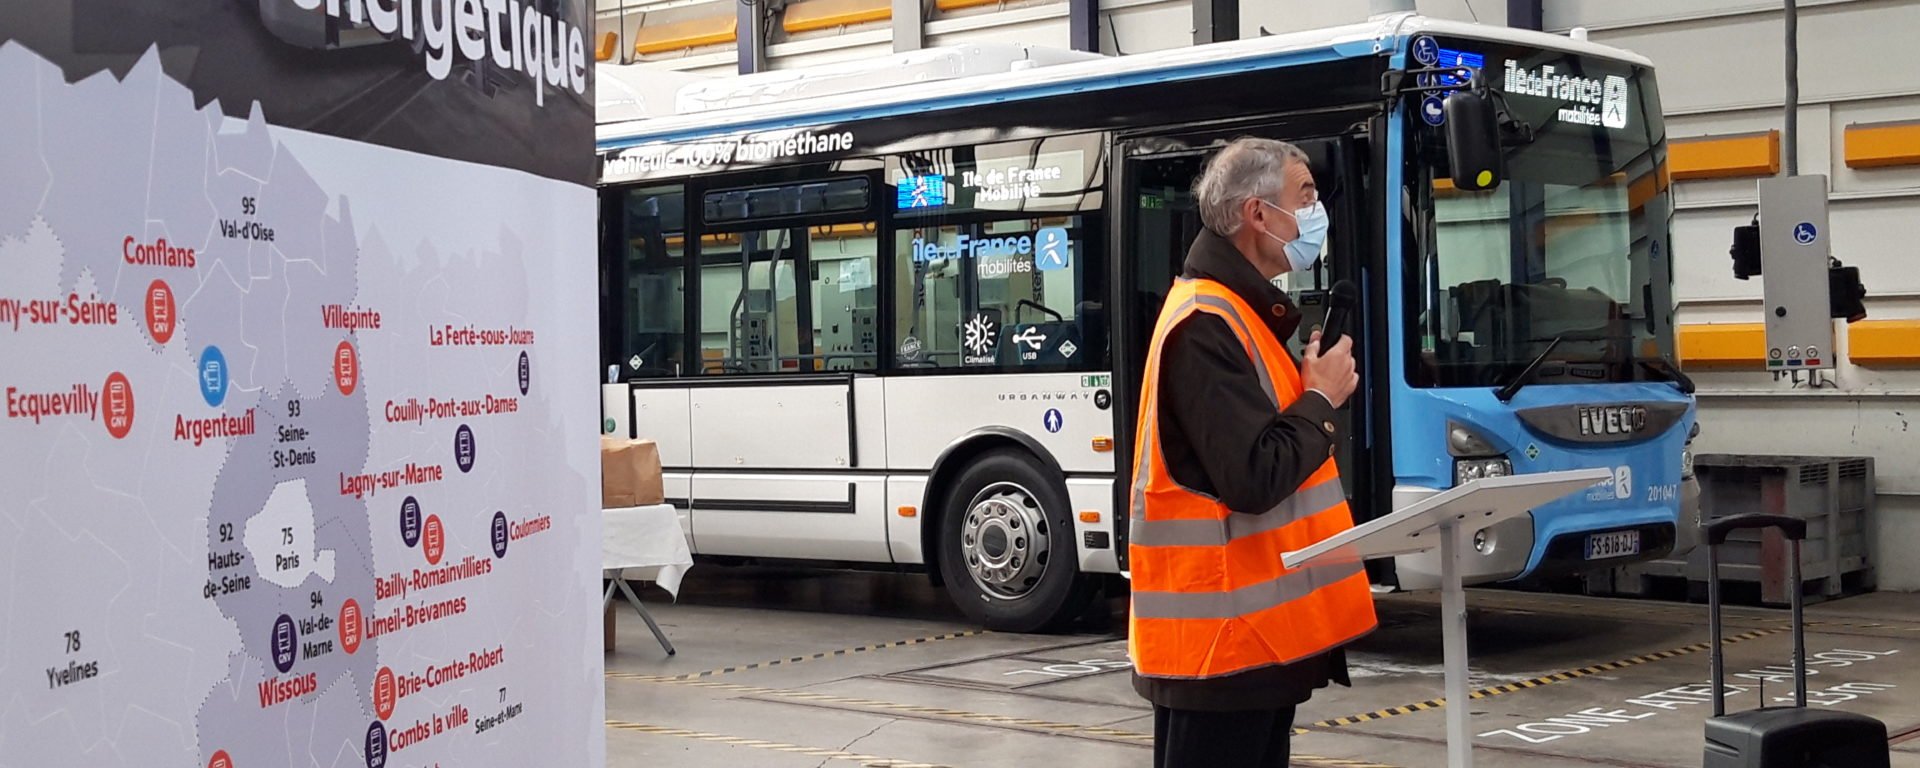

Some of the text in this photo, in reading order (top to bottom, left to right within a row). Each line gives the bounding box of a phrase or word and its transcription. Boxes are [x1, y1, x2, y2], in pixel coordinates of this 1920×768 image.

[683, 142, 731, 168] 100%
[735, 129, 853, 163] biométhane
[962, 165, 1062, 188] Ile de France
[980, 181, 1041, 203] Mobilité
[242, 197, 256, 215] 95
[220, 219, 275, 242] Val-d'Oise
[123, 235, 196, 268] Conflans
[977, 254, 1032, 276] mobilités
[322, 304, 381, 333] Villepinte
[430, 325, 443, 345] La
[964, 354, 995, 364] Climatisé
[1022, 352, 1037, 360] USB
[6, 384, 98, 425] Ecquevilly
[998, 392, 1089, 401] URBANWAY
[288, 400, 301, 418] 93
[385, 394, 518, 425] Couilly-Pont-aux-Dames
[1579, 404, 1647, 435] IVECO
[110, 416, 127, 428] GNV
[174, 407, 256, 446] Argenteuil
[278, 425, 309, 443] Seine-
[273, 446, 316, 468] St-Denis
[339, 462, 442, 499] Lagny-sur-Marne
[1647, 484, 1677, 502] 201047
[219, 523, 234, 542] 92
[281, 527, 294, 546] 75
[510, 512, 551, 541] Coulommiers
[1591, 533, 1633, 555] FS-618-DJ
[208, 550, 245, 571] Hauts-
[275, 551, 300, 571] Paris
[203, 575, 251, 599] de-Seine
[375, 556, 492, 600] Bailly-Romainvilliers
[310, 591, 323, 609] 94
[299, 613, 334, 636] Val-de-
[365, 597, 467, 639] Limeil-Brévannes
[63, 630, 81, 654] 78
[303, 639, 333, 660] Marne
[46, 657, 99, 690] Yvelines
[398, 644, 504, 698] Brie-Comte-Robert
[258, 672, 317, 709] Wissous
[499, 687, 506, 703] 77
[1477, 707, 1657, 743] ZONE
[1625, 680, 1748, 710] ATEX
[1805, 648, 1899, 667] SOL
[389, 704, 469, 752] Combs la ville
[475, 702, 523, 734] Seine-et-Marne
